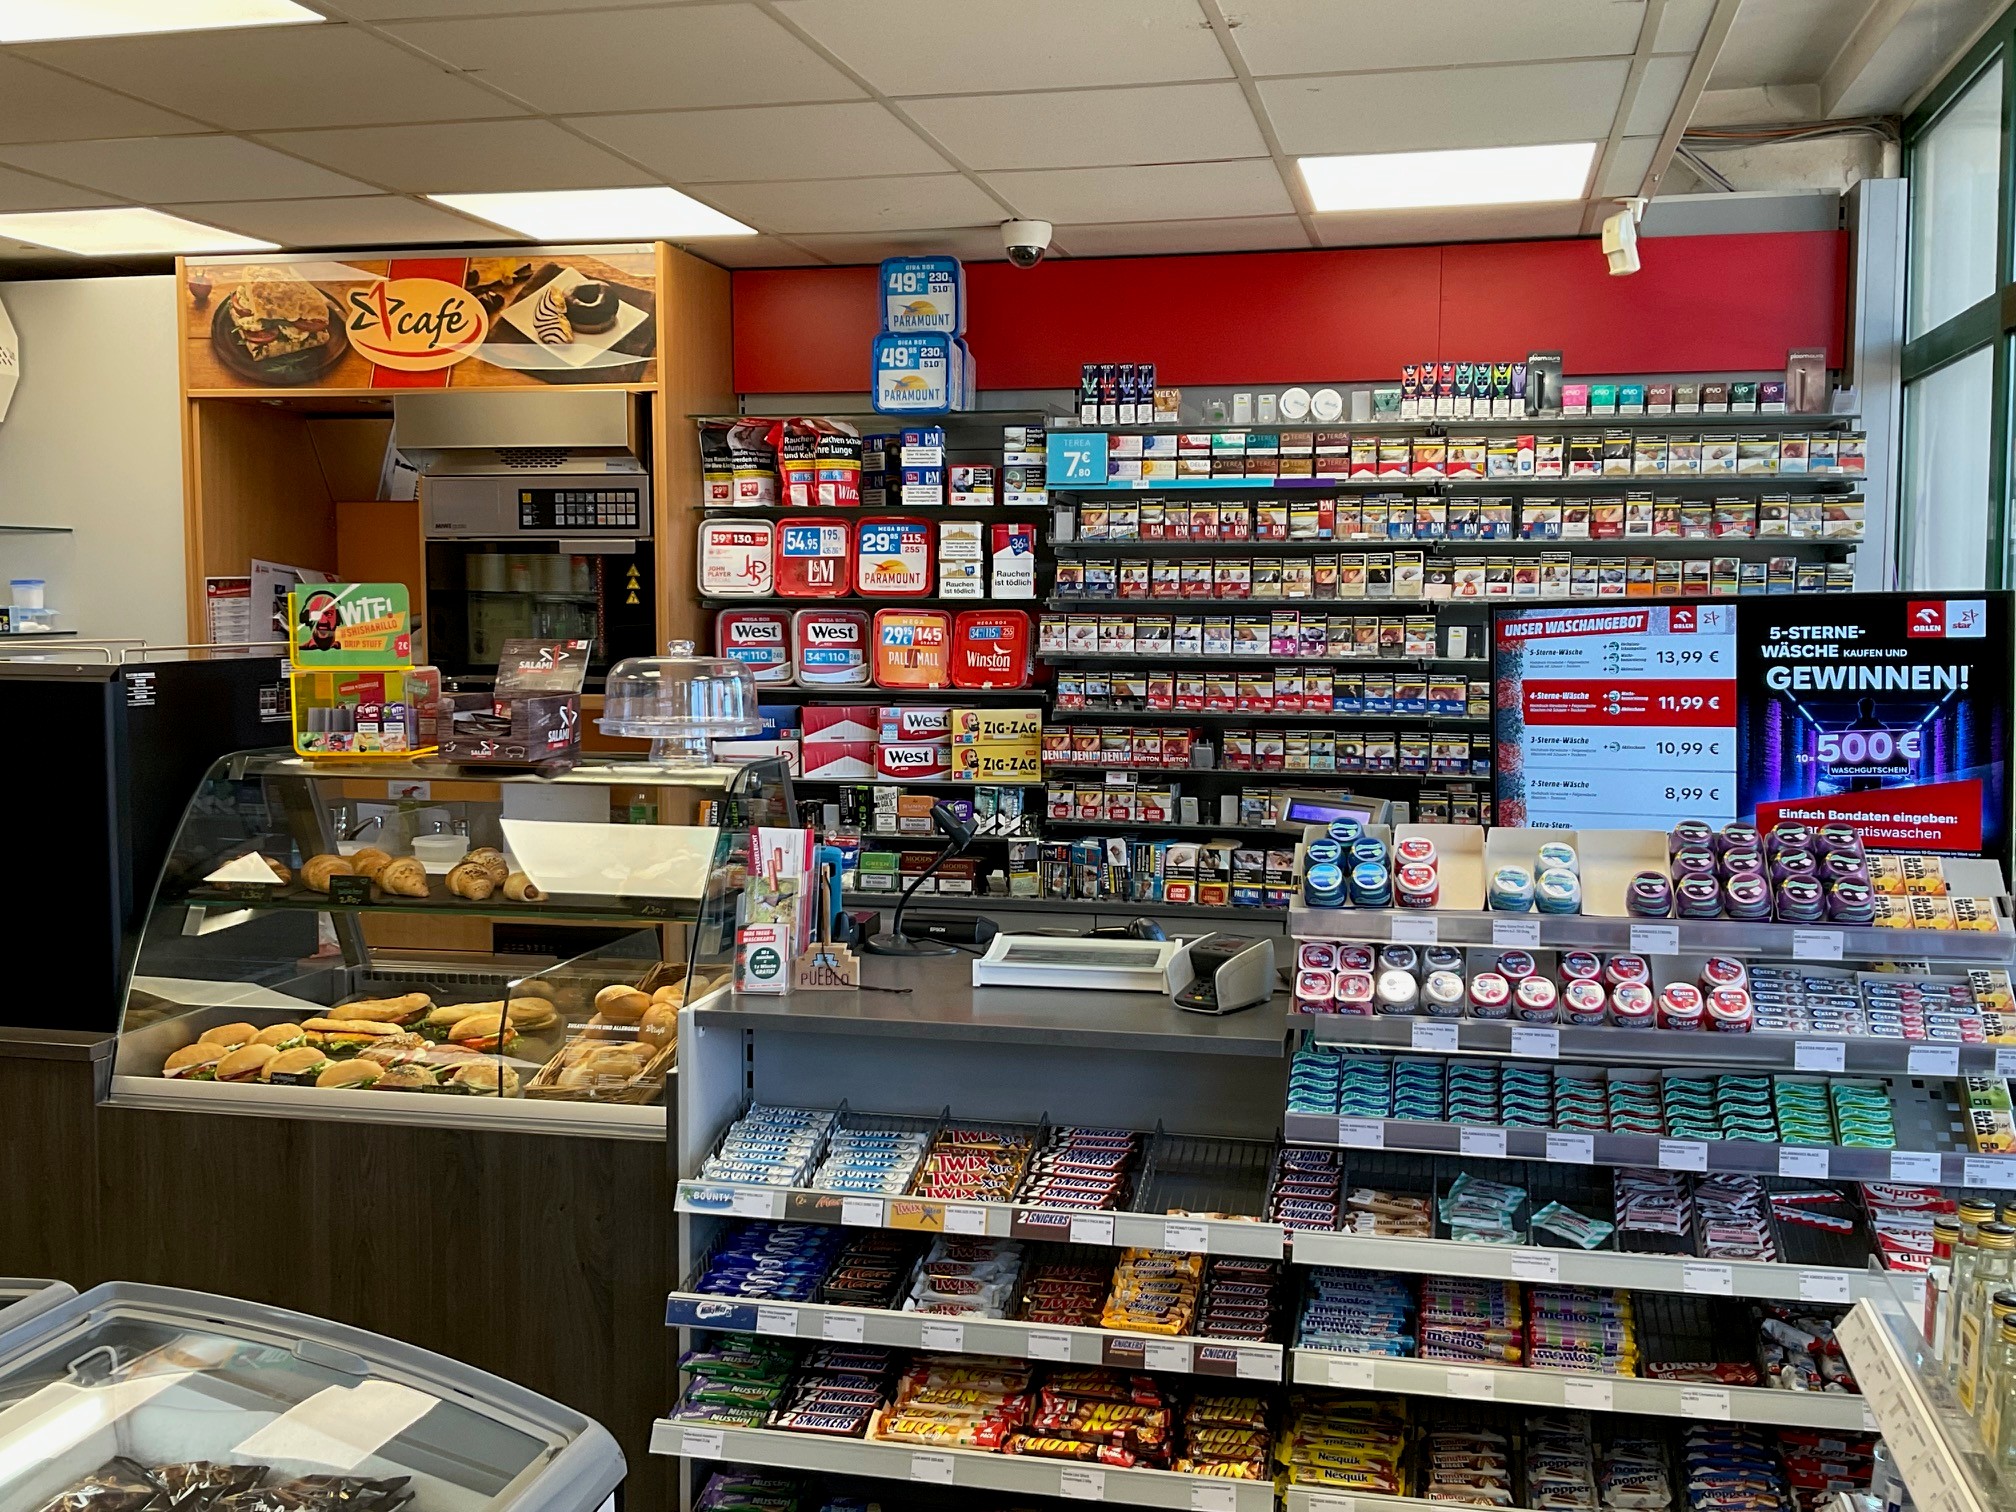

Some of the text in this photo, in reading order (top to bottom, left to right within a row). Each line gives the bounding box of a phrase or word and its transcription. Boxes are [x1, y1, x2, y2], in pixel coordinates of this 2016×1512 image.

[889, 272, 917, 293] 49
[397, 298, 471, 349] café
[894, 314, 950, 327] PARAMOUNT
[881, 347, 909, 368] 49
[885, 388, 940, 401] PARAMOUNT
[1155, 390, 1178, 398] VEEV
[1650, 387, 1666, 395] evo
[1706, 387, 1721, 395] evo
[1063, 438, 1091, 447] TEREA
[1326, 432, 1347, 440] TEREA
[862, 532, 889, 552] 29
[808, 560, 834, 582] L&M
[864, 571, 921, 584] PARAMOUNT
[996, 570, 1031, 578] Rauchen
[1005, 579, 1032, 587] tödlich
[340, 596, 393, 627] WTF!
[340, 618, 399, 638] #SHISHARILLO
[735, 625, 778, 638] West
[1504, 614, 1644, 636] UNSER WASCHANGEBOT
[1913, 624, 1942, 632] ORLEN
[1952, 621, 1973, 630] star
[812, 626, 855, 639] West
[884, 626, 903, 645] 29
[915, 627, 943, 641] 145
[1769, 625, 1866, 640] 5-STERNE-
[344, 639, 384, 649] DRIP STUFF
[1761, 642, 1908, 658] WÄSCHE KAUFEN UND
[888, 651, 939, 667] PALL MALL
[966, 650, 1011, 668] Winston
[1529, 648, 1583, 656] 5-Sterne-Wäsche
[1656, 650, 1703, 666] 13,99
[1708, 650, 1719, 663] €
[518, 660, 553, 670] SALAMI
[1766, 664, 1969, 691] GEWINNEN!
[1529, 691, 1589, 700] 4-Sterne-Wäsche
[1658, 696, 1719, 711] 11,99 €
[907, 714, 949, 728] West
[984, 721, 1037, 734] ZIG-ZAG
[547, 729, 570, 744] SALAMI
[1530, 735, 1589, 744] 3-Sterne-Wäsche
[1656, 741, 1719, 757] 10,99 €
[888, 750, 929, 764] West
[1796, 754, 1815, 764] 10x
[983, 758, 1038, 771] ZIG-ZAG
[1830, 766, 1908, 774] WASCHGUTSCHEIN
[1530, 779, 1589, 789] 2-Sterne-Wäsche
[1664, 787, 1719, 803] 8,99 €
[1531, 820, 1573, 829] Extra-Stern-
[1778, 808, 1959, 827] Einfach Bondaten eingeben:
[752, 834, 763, 875] PFLEGELEICHT
[904, 854, 933, 863] MOODS
[943, 862, 969, 870] MOODS
[1905, 857, 1915, 880] VITA
[1913, 857, 1924, 880] VATE
[1102, 863, 1110, 889] DRUM
[1911, 897, 1923, 920] VITA
[1922, 897, 1935, 921] VATE
[1954, 898, 1966, 922] VITA
[1964, 898, 1978, 922] VATE
[800, 967, 850, 986] PUEBLO
[567, 1023, 603, 1031] ZUSATZSTOFFE
[732, 1140, 787, 1153] BOUNTY
[714, 1159, 770, 1173] BOUNTY
[932, 1153, 1017, 1177] TWIX Xtra
[711, 1169, 768, 1184] BOUNTY
[827, 1168, 882, 1180] BOUNTY
[927, 1171, 1011, 1190] TWIX Xtra
[823, 1178, 880, 1190] BOUNTY
[1053, 1177, 1112, 1190] SNICKERS
[693, 1191, 732, 1202] BOUNTY
[1044, 1188, 1103, 1201] SNICKERS
[1279, 1186, 1335, 1197] SNICKERS
[1282, 1197, 1335, 1210] SNICKERS
[1030, 1213, 1069, 1226] SNICKERS
[934, 1279, 978, 1293] TWIX
[1320, 1281, 1373, 1293] mentos
[1536, 1310, 1597, 1324] mentos
[1113, 1340, 1144, 1349] SNICKERS
[1426, 1331, 1484, 1351] mentos
[821, 1391, 882, 1405] SNICKERS
[808, 1403, 870, 1418] SNICKERS
[796, 1416, 858, 1430] SNICKERS
[1026, 1436, 1080, 1452] LION
[1317, 1451, 1361, 1466] Nesquik
[1324, 1469, 1369, 1483] Nesquik
